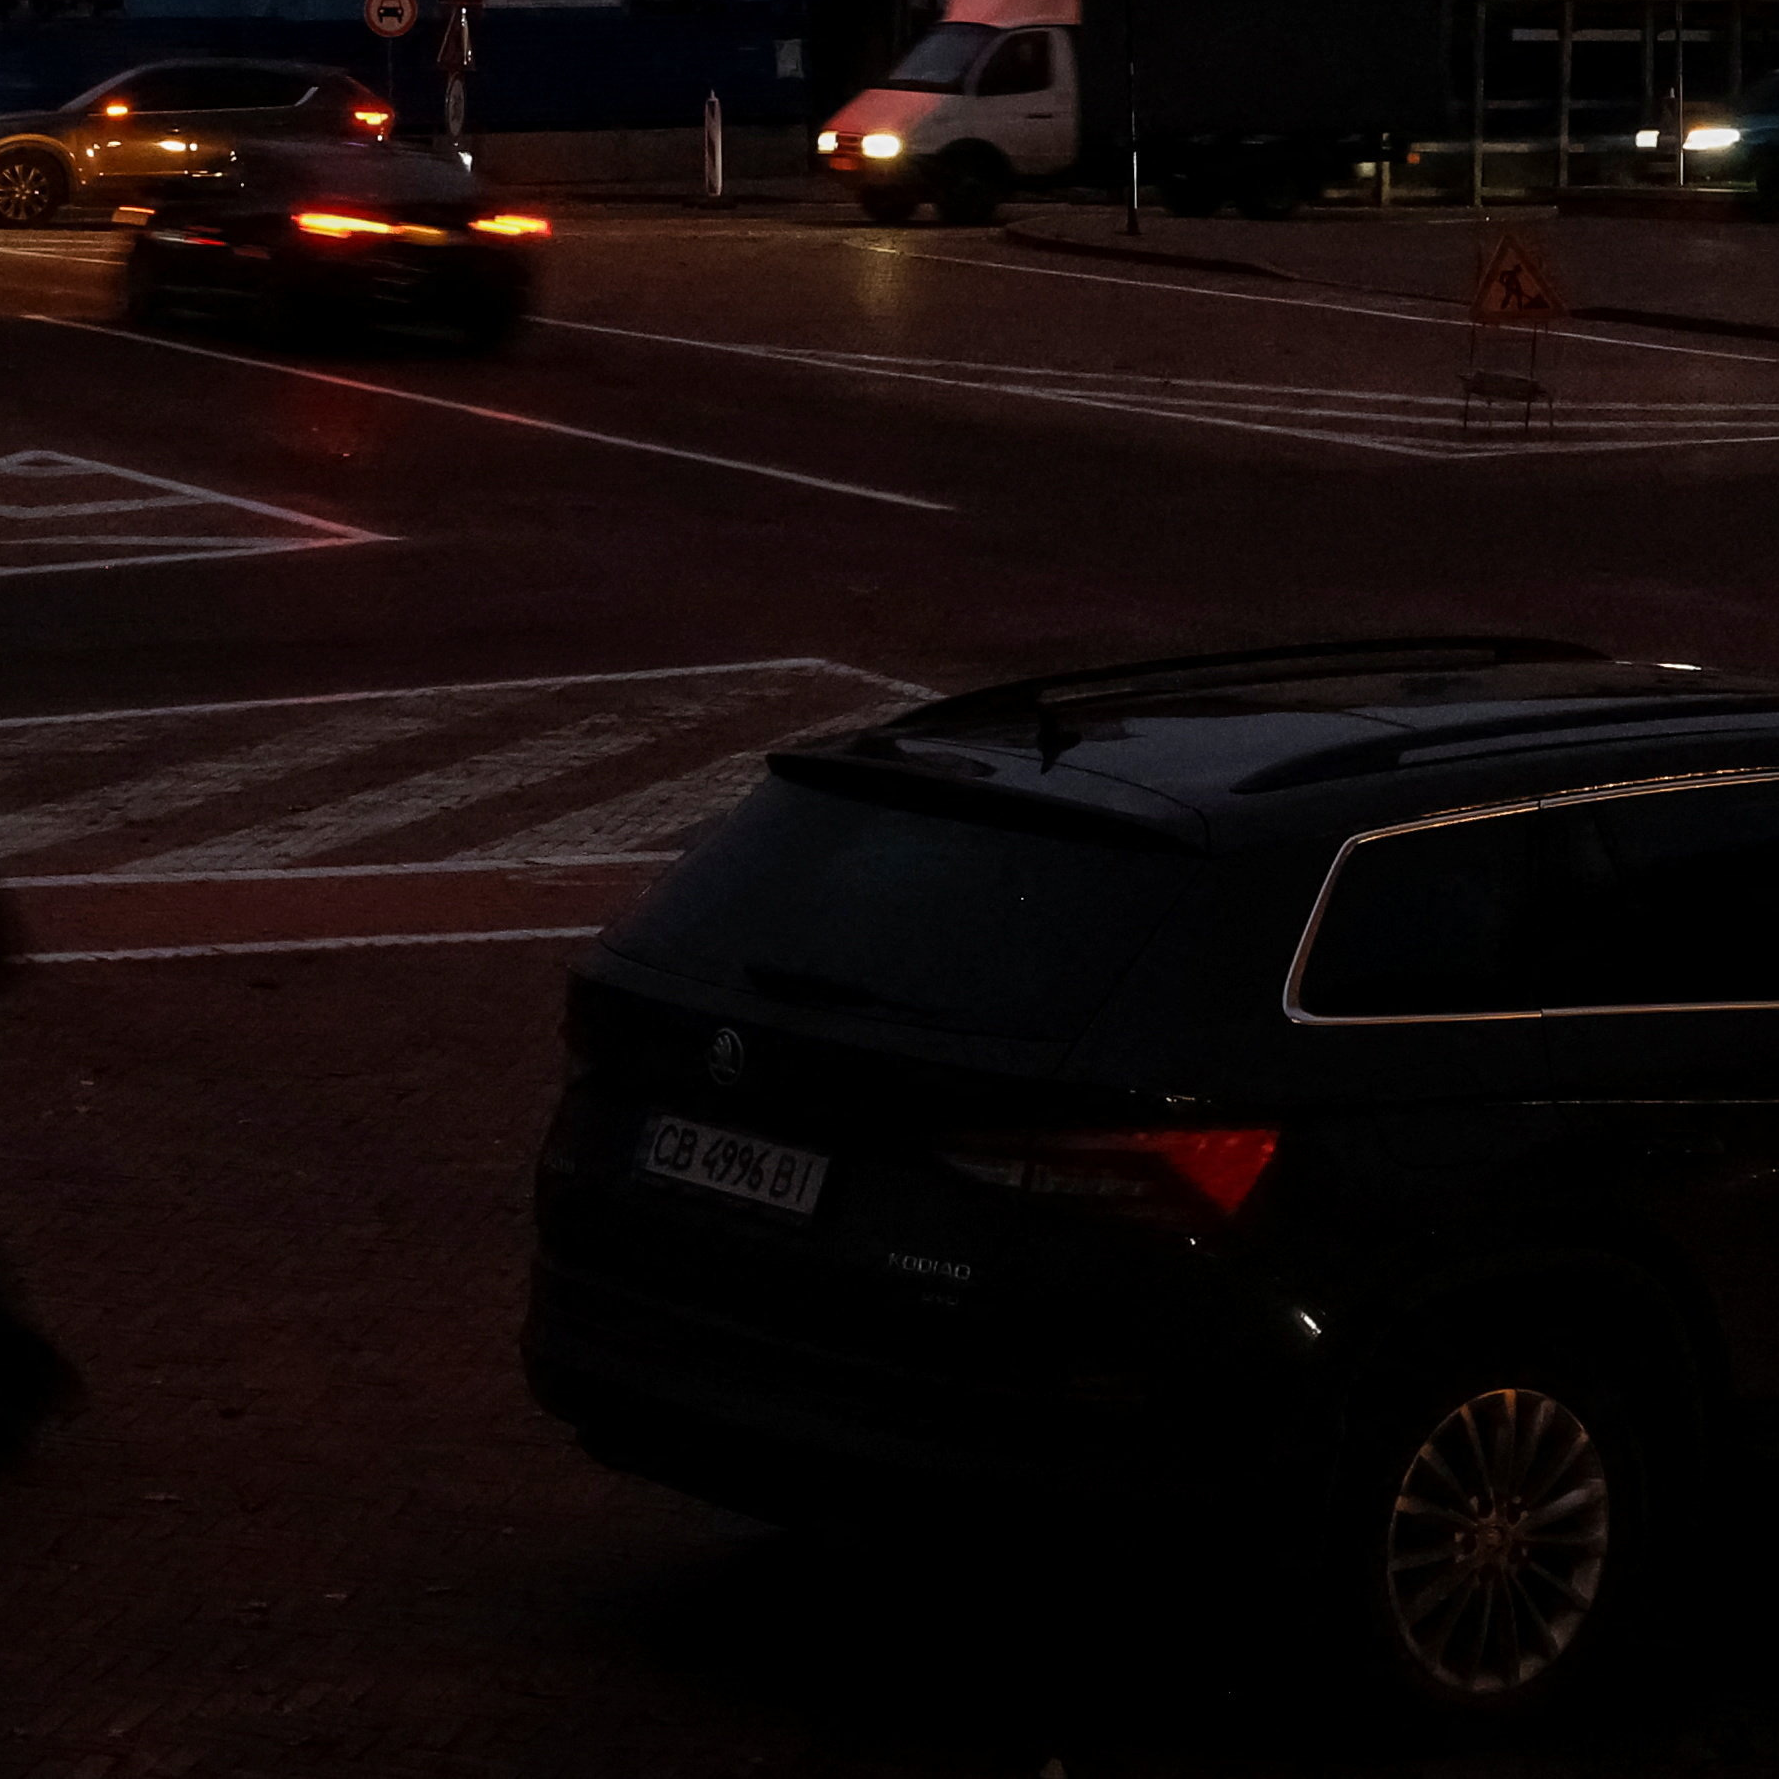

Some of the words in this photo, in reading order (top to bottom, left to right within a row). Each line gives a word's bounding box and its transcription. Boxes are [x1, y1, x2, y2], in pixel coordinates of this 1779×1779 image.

[654, 1123, 699, 1171] CB
[702, 1136, 771, 1192] 4996
[888, 1251, 971, 1280] KODIAQ
